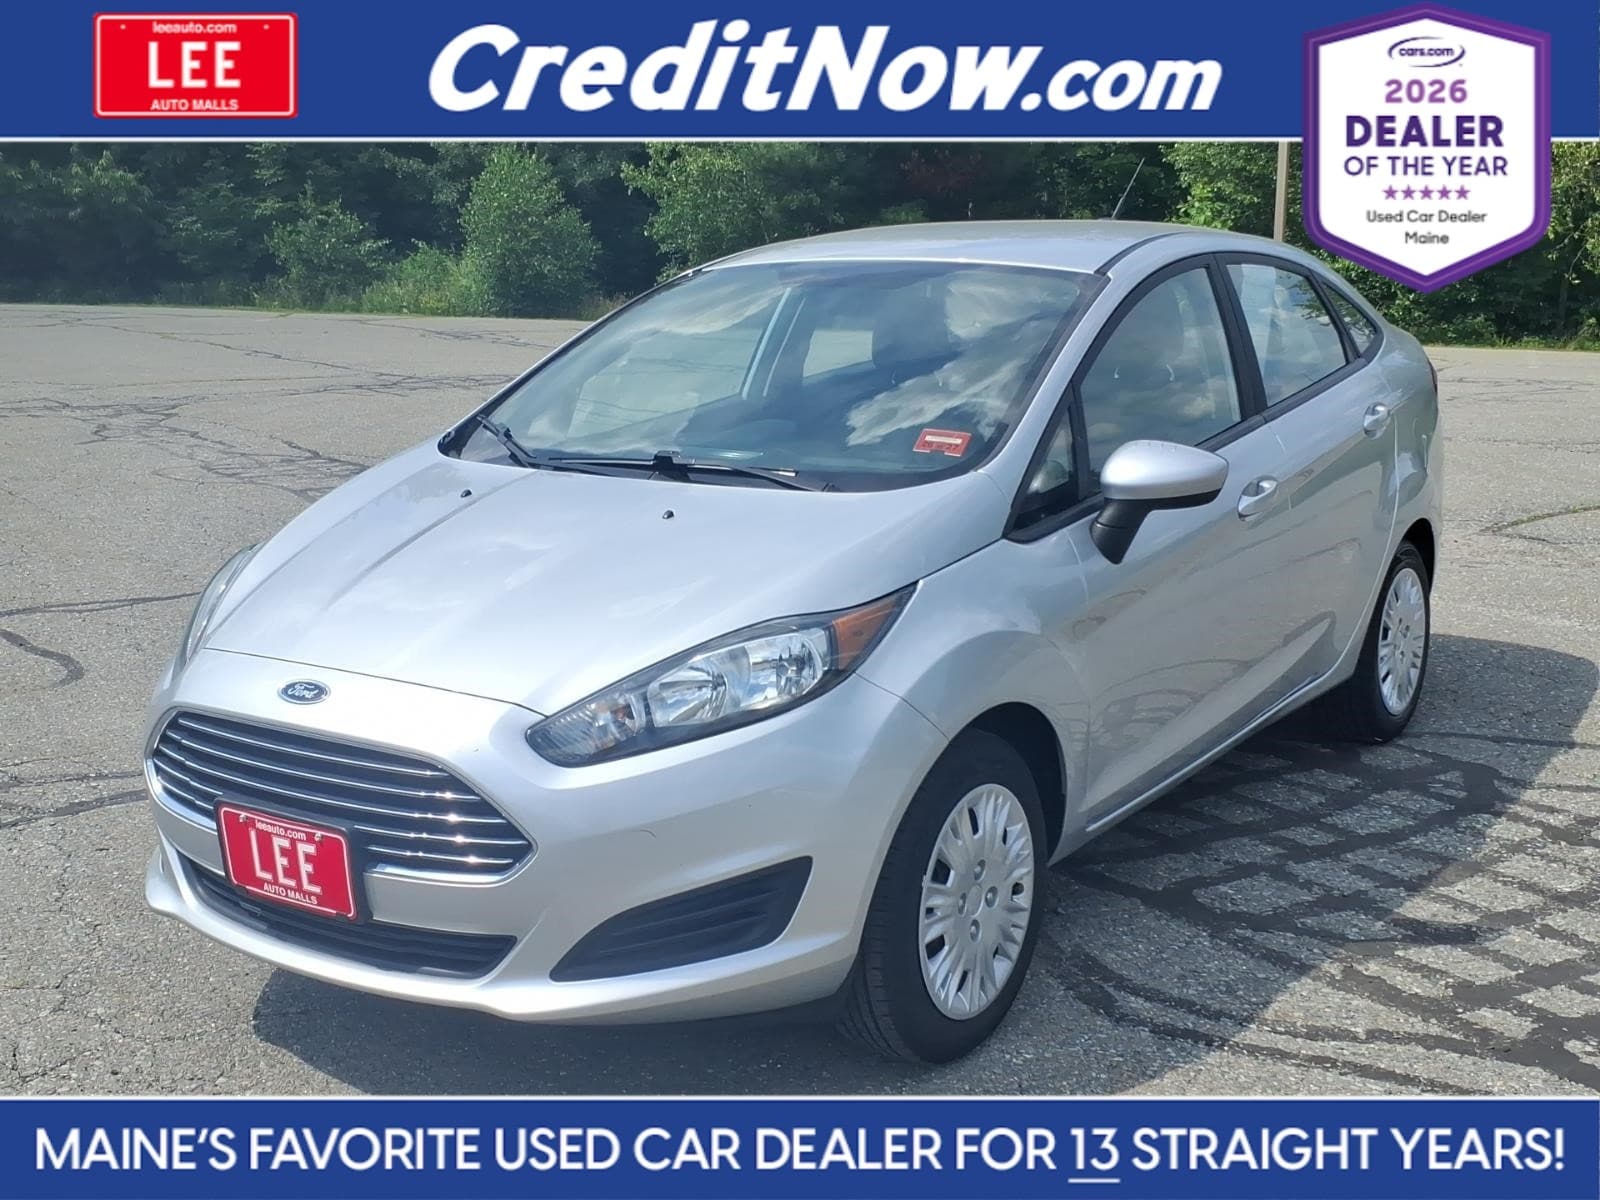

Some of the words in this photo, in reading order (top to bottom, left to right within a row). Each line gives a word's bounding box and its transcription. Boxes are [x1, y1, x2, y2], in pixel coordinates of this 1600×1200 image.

[285, 682, 319, 699] Ford
[254, 819, 307, 841] leeauto.com
[249, 828, 321, 894] LEE
[263, 882, 286, 897] AUTO
[287, 889, 318, 906] MALLS
